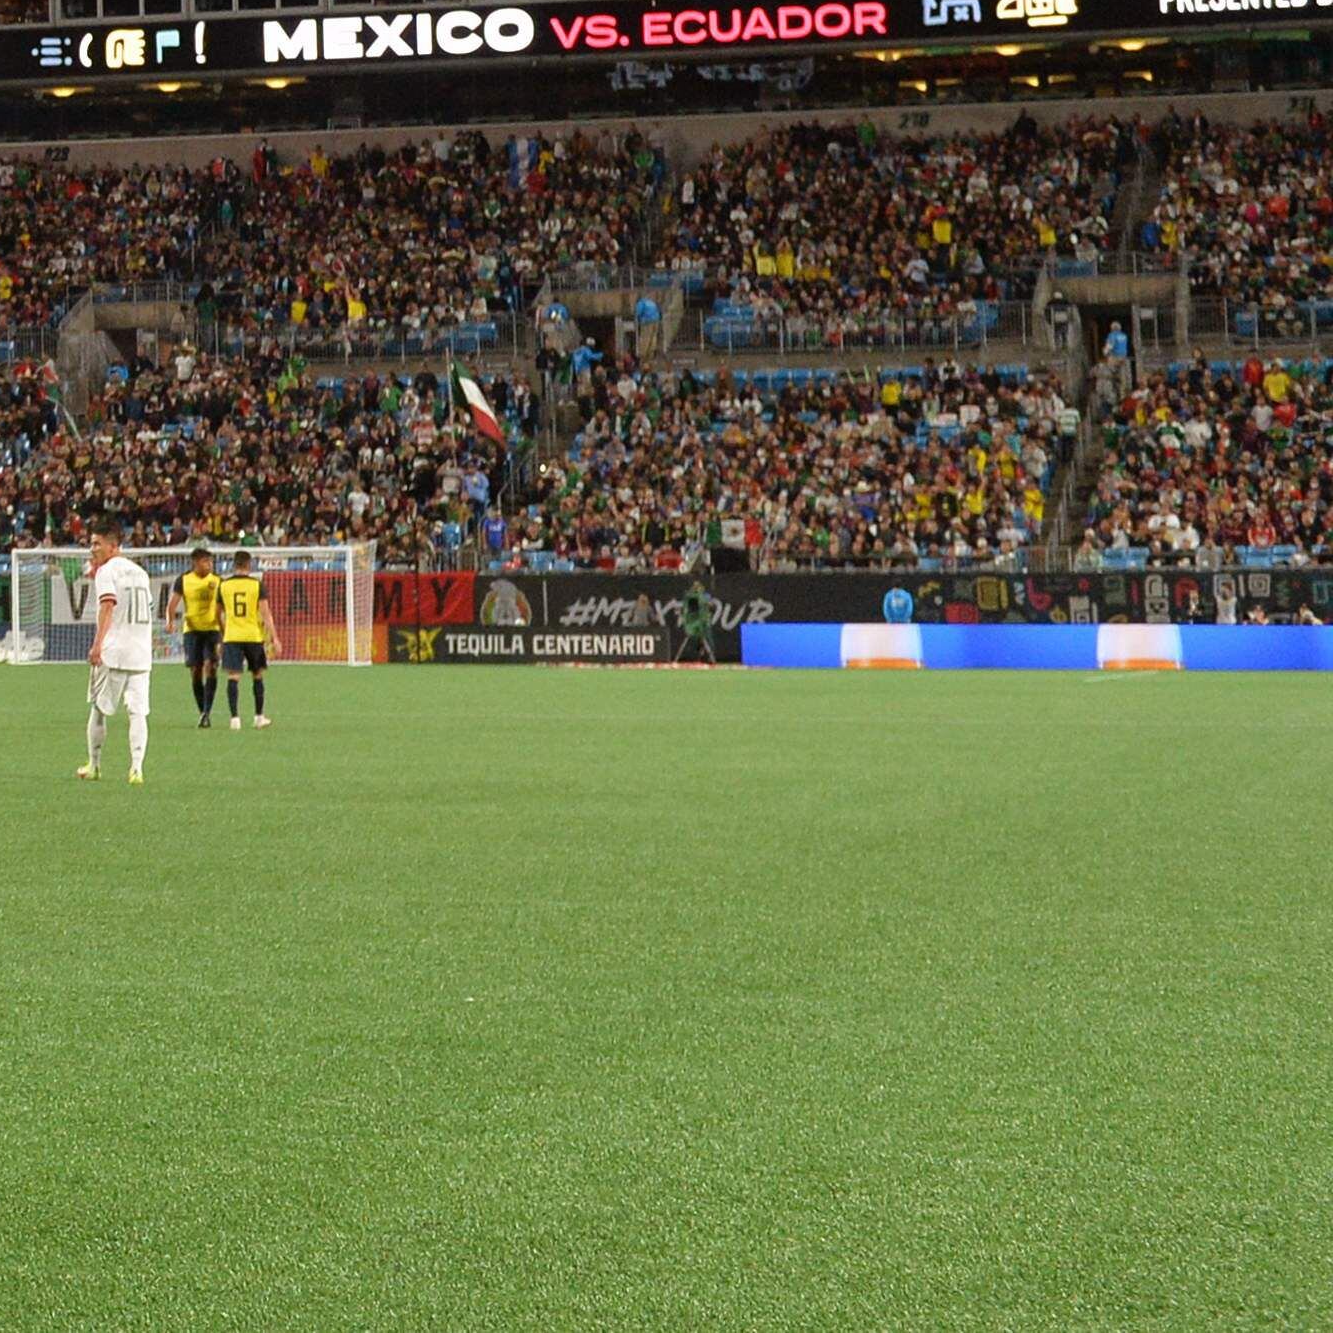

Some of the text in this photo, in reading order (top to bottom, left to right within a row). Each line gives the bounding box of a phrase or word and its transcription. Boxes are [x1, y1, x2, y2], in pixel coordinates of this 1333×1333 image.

[263, 2, 887, 63] MEXICO VS. ECUADOR
[126, 587, 150, 624] 10
[233, 592, 247, 617] 6
[445, 634, 654, 656] TEQUILA CENTENARIO
